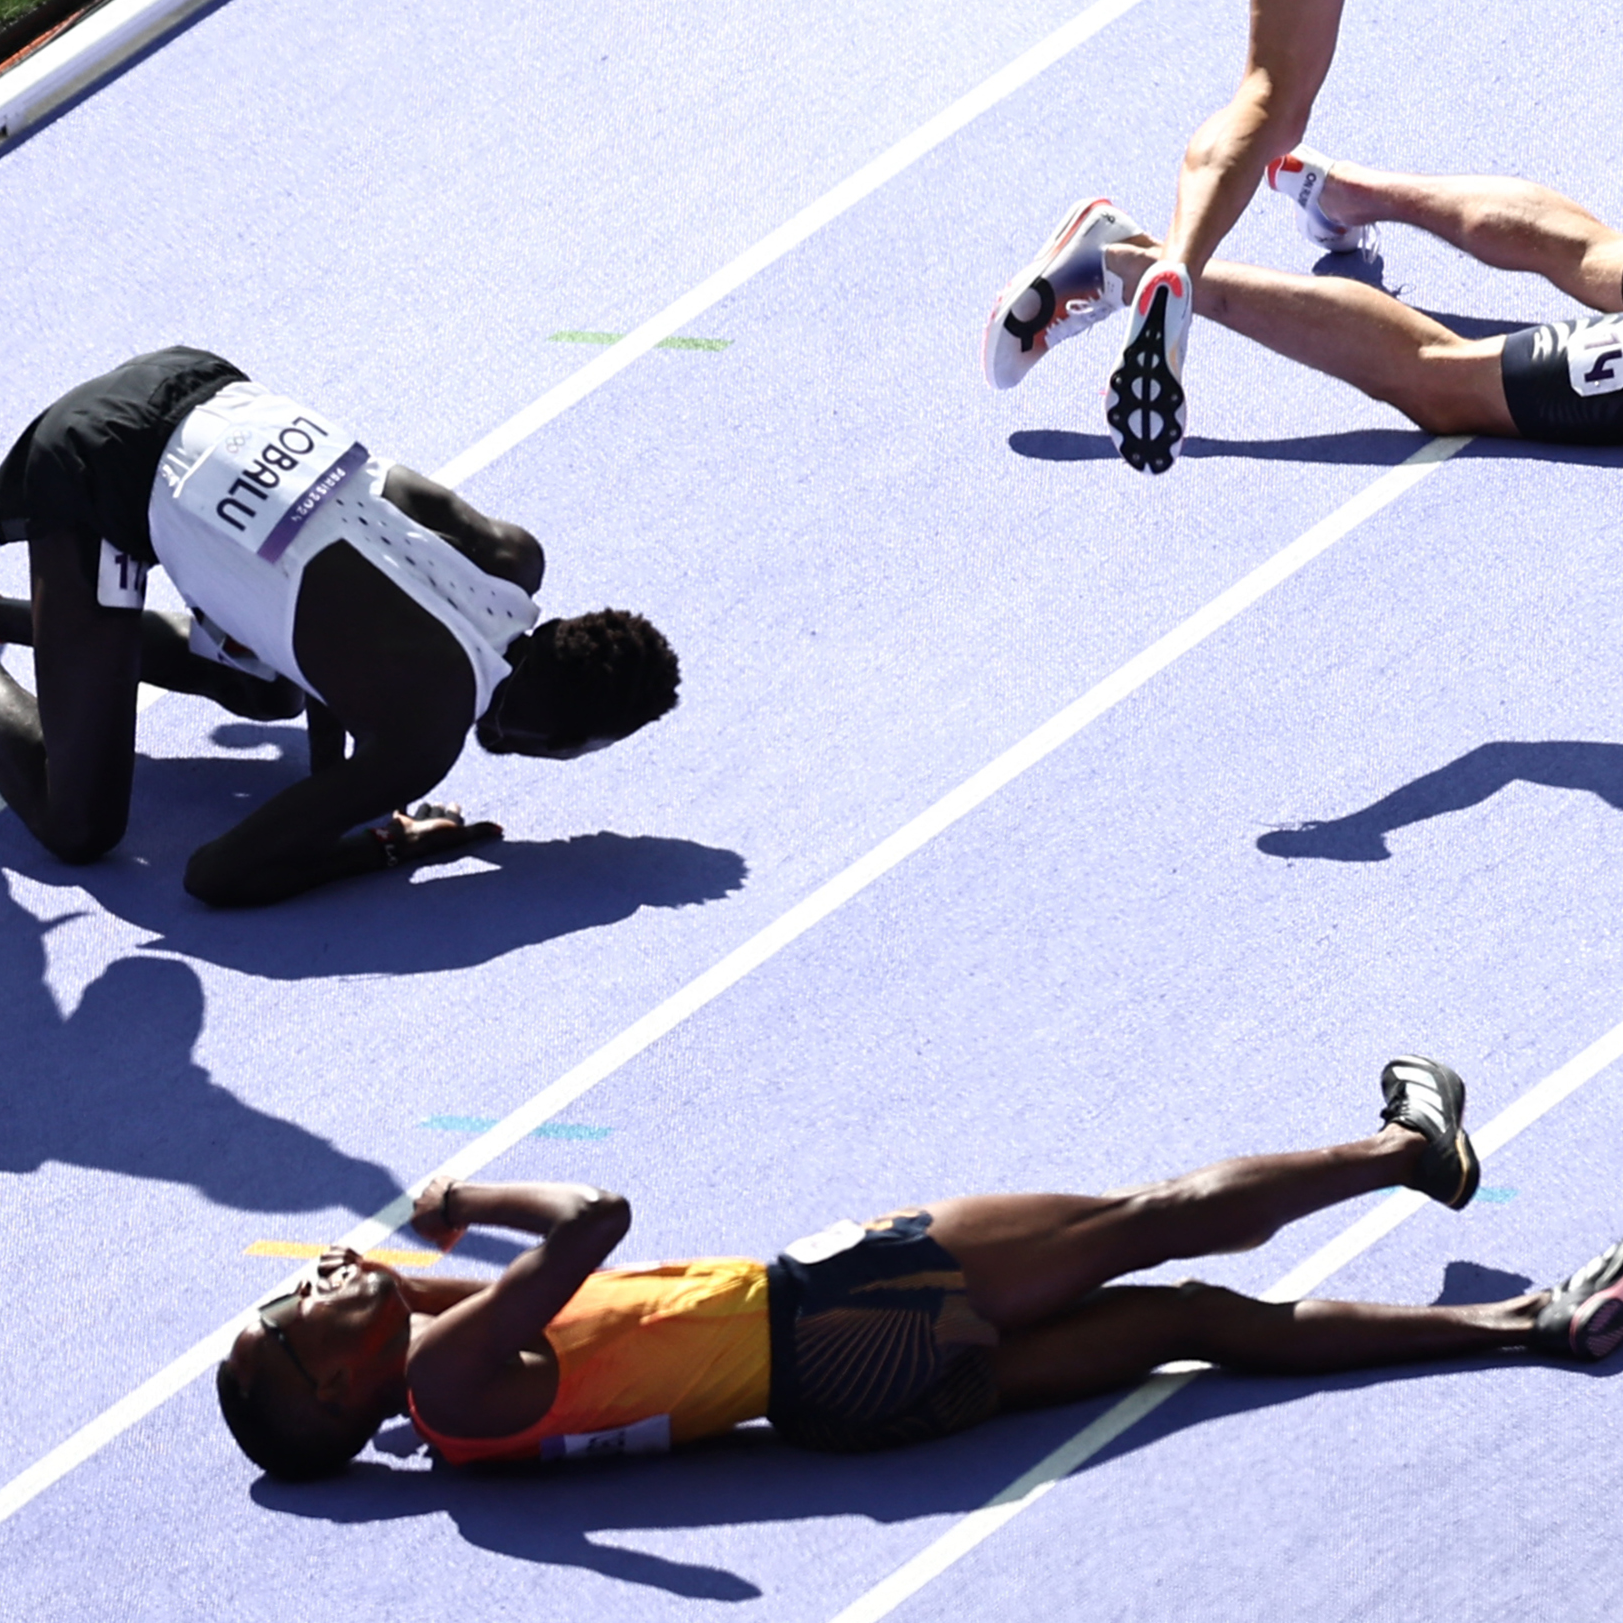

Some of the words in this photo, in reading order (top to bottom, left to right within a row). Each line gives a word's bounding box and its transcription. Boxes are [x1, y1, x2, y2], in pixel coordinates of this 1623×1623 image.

[1584, 332, 1623, 383] 14
[216, 416, 329, 532] LOBALU
[291, 491, 321, 522] 2024
